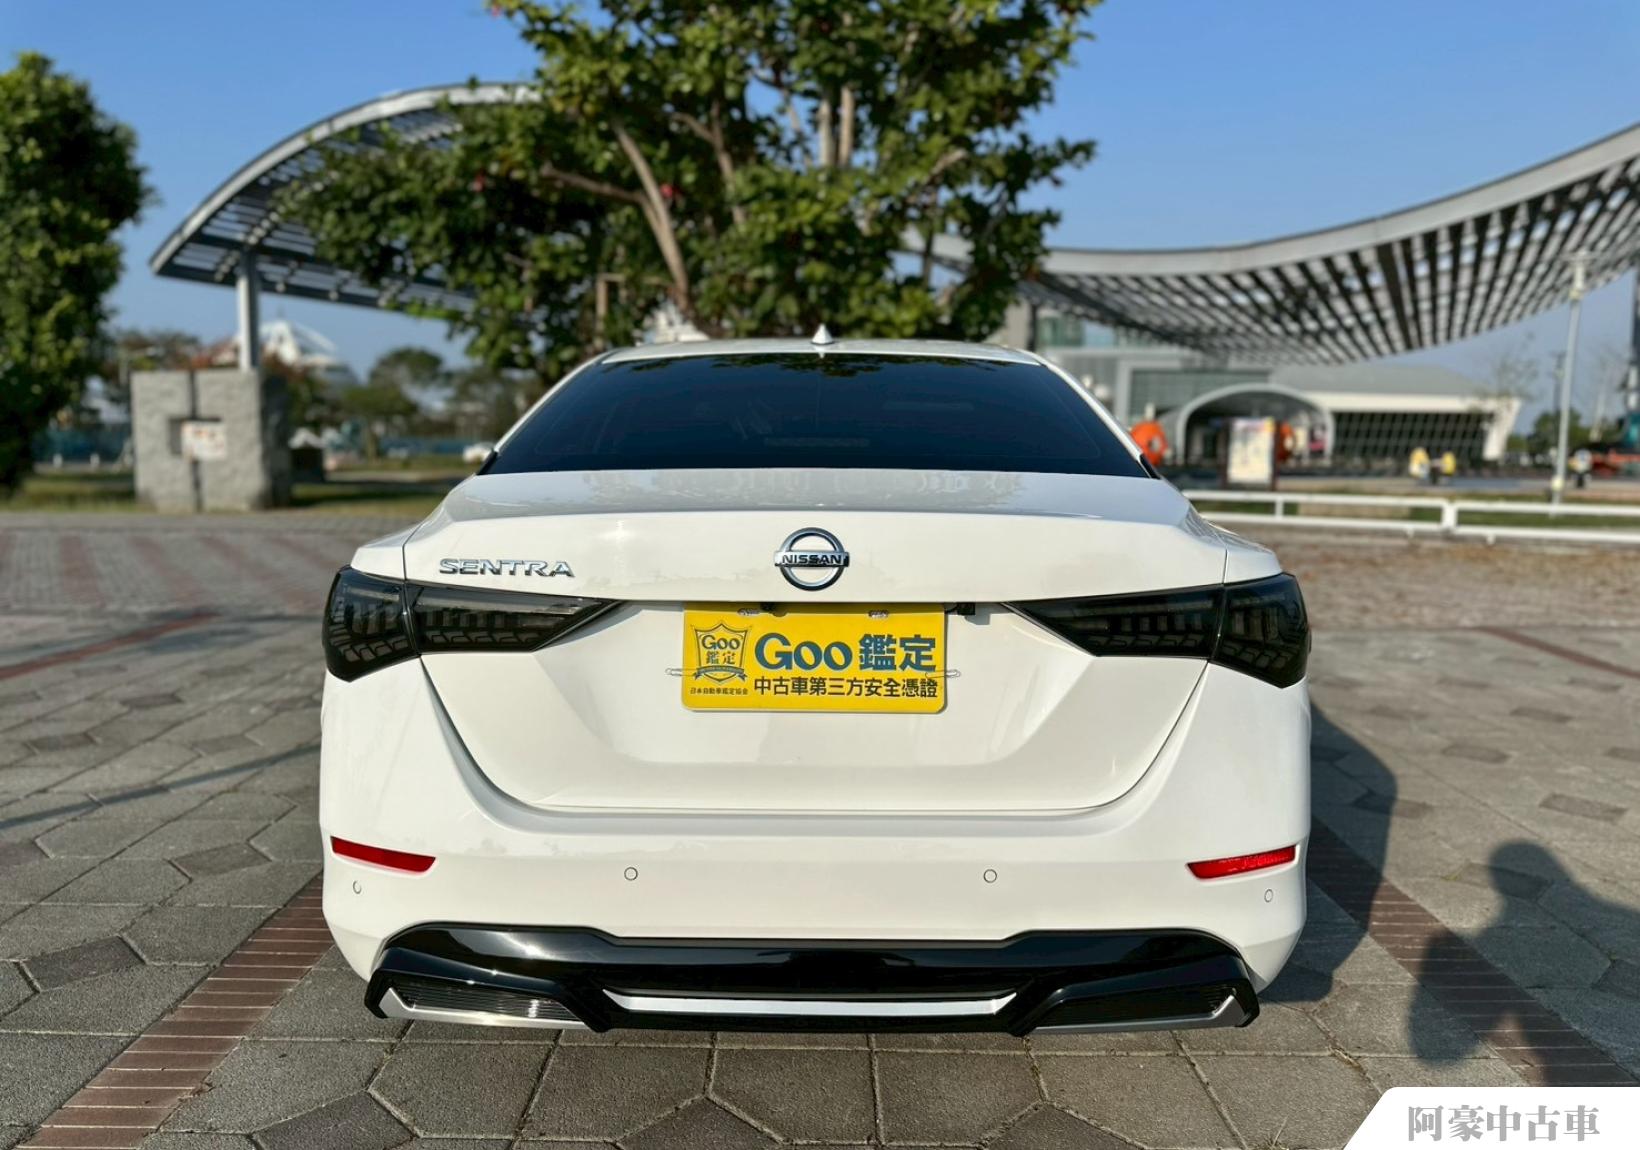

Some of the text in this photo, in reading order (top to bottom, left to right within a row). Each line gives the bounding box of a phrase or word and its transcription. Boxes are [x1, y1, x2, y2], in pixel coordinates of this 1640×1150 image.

[439, 558, 575, 577] SENTRA
[782, 554, 842, 564] NISSAN
[701, 634, 740, 650] Goo
[755, 633, 937, 671] Goo 鑑定
[754, 676, 938, 698] 中古車第三方安全憑證
